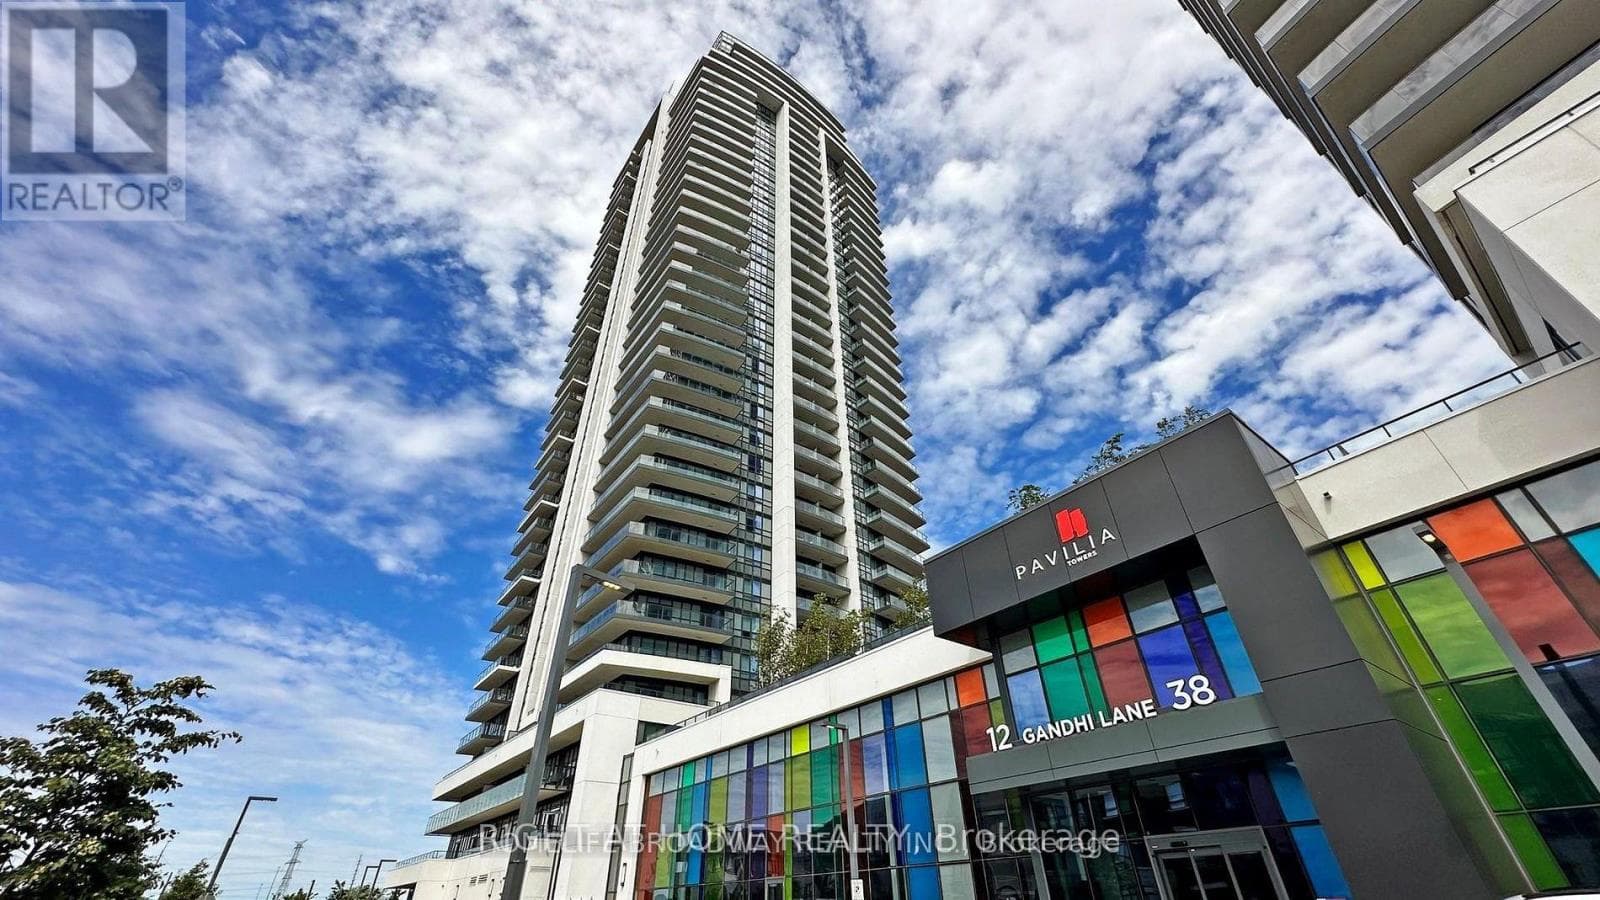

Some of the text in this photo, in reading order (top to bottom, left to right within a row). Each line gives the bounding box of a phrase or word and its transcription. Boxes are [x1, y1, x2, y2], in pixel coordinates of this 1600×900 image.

[1014, 528, 1116, 580] PAVILIA
[1066, 550, 1098, 567] TOWERS
[985, 674, 1217, 752] 12 GANDHI LANE 38
